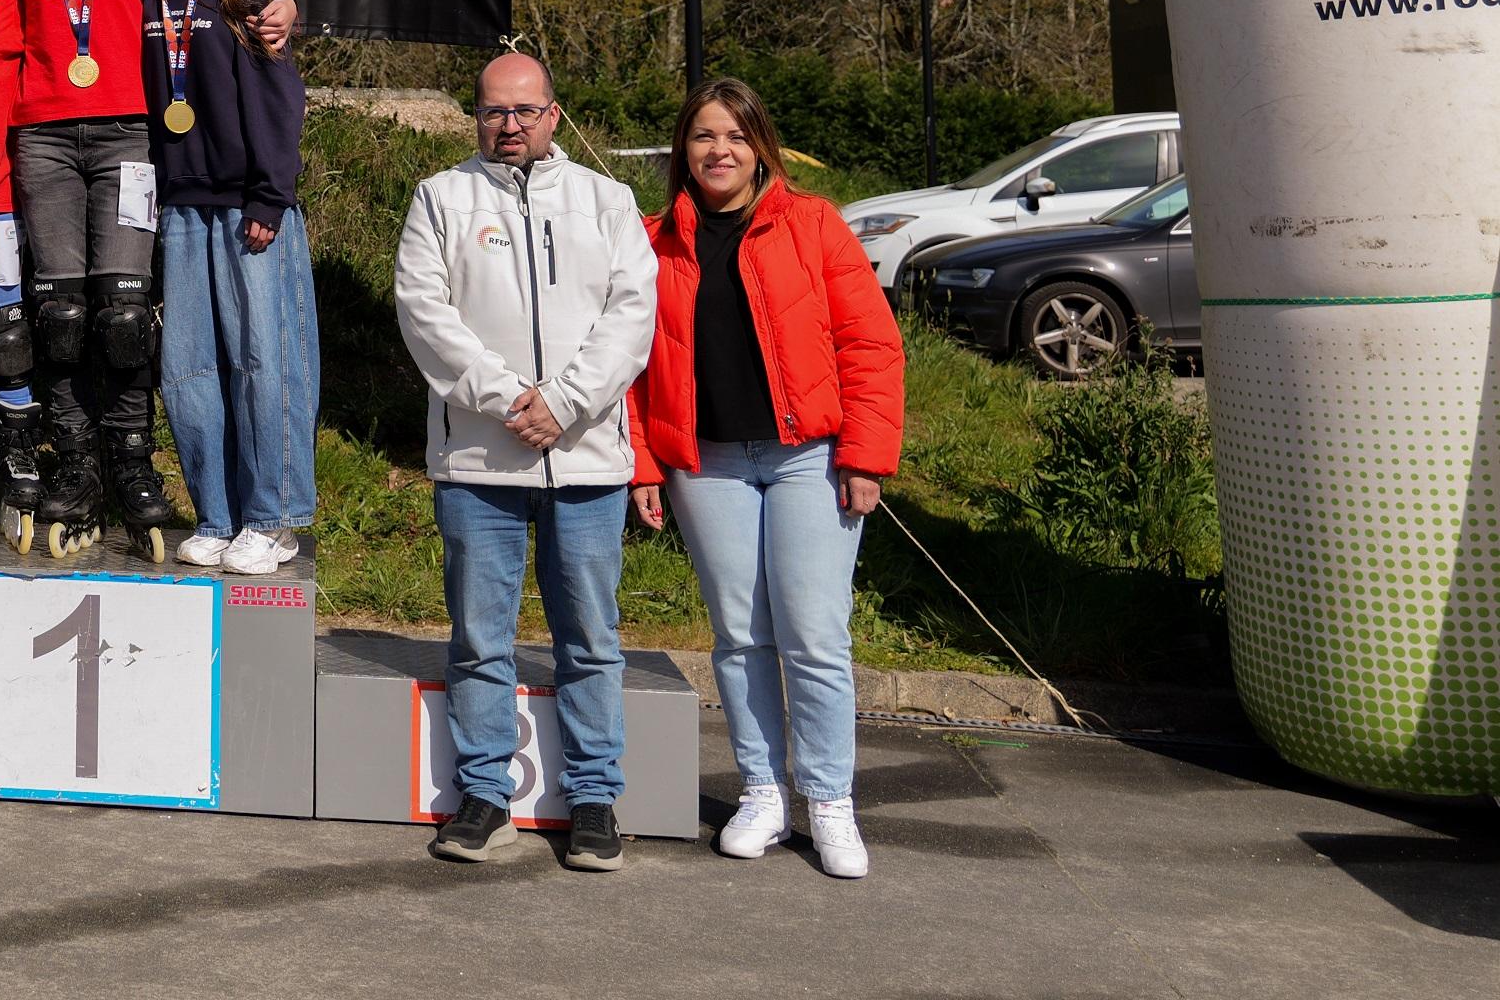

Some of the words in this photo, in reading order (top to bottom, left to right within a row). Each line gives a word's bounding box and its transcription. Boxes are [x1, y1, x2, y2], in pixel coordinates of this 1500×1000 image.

[489, 237, 510, 248] RFEP
[230, 585, 304, 600] SOFTEE
[33, 594, 101, 779] 1
